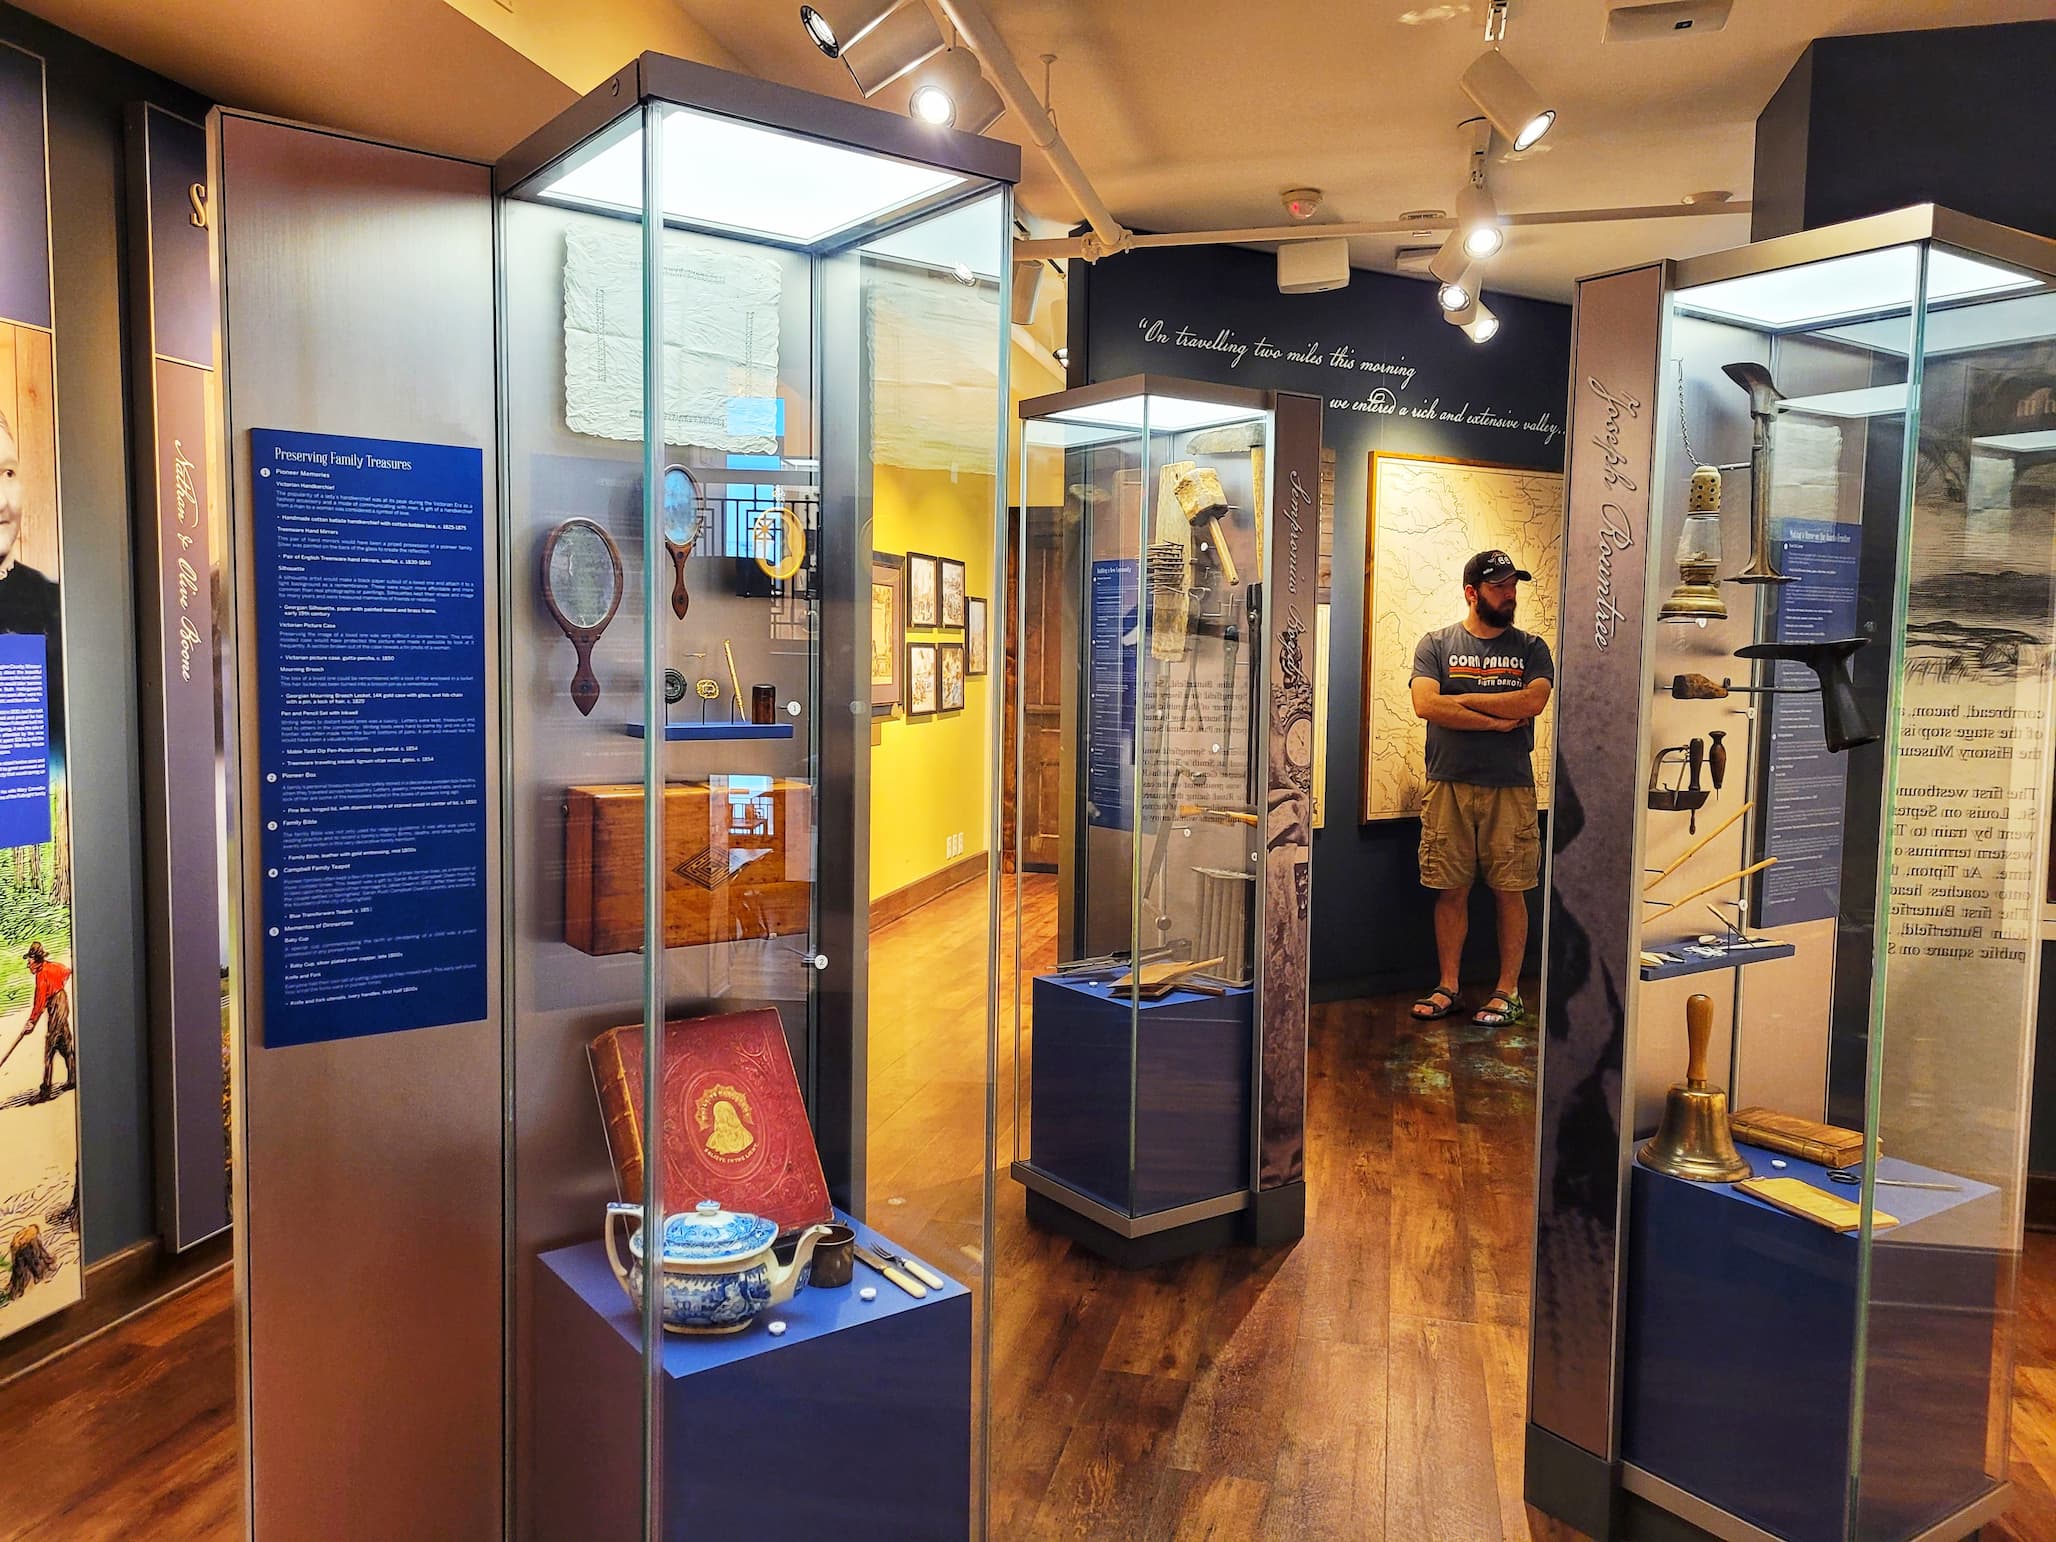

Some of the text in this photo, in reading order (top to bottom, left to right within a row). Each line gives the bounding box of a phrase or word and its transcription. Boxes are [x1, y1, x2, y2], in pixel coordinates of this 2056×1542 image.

[190, 183, 208, 231] S
[1175, 325, 1248, 368] travelling
[1254, 337, 1283, 359] two
[1287, 342, 1324, 366] miles
[1329, 345, 1356, 369] this
[1360, 356, 1417, 390] morning
[1329, 397, 1350, 409] we
[1352, 387, 1397, 415] entered
[1398, 406, 1409, 416] a
[1411, 397, 1438, 419] rich
[1439, 402, 1469, 422] and
[1466, 407, 1520, 429] extensive
[275, 447, 412, 470] Preserving Family Treasures
[276, 468, 330, 478] Pioneer Memories
[1284, 470, 1311, 594] Sempronius
[1587, 376, 1640, 651] Joseph Rountree
[174, 439, 202, 683] Nathan & Olive Boone
[1449, 655, 1524, 669] CORN PALACE
